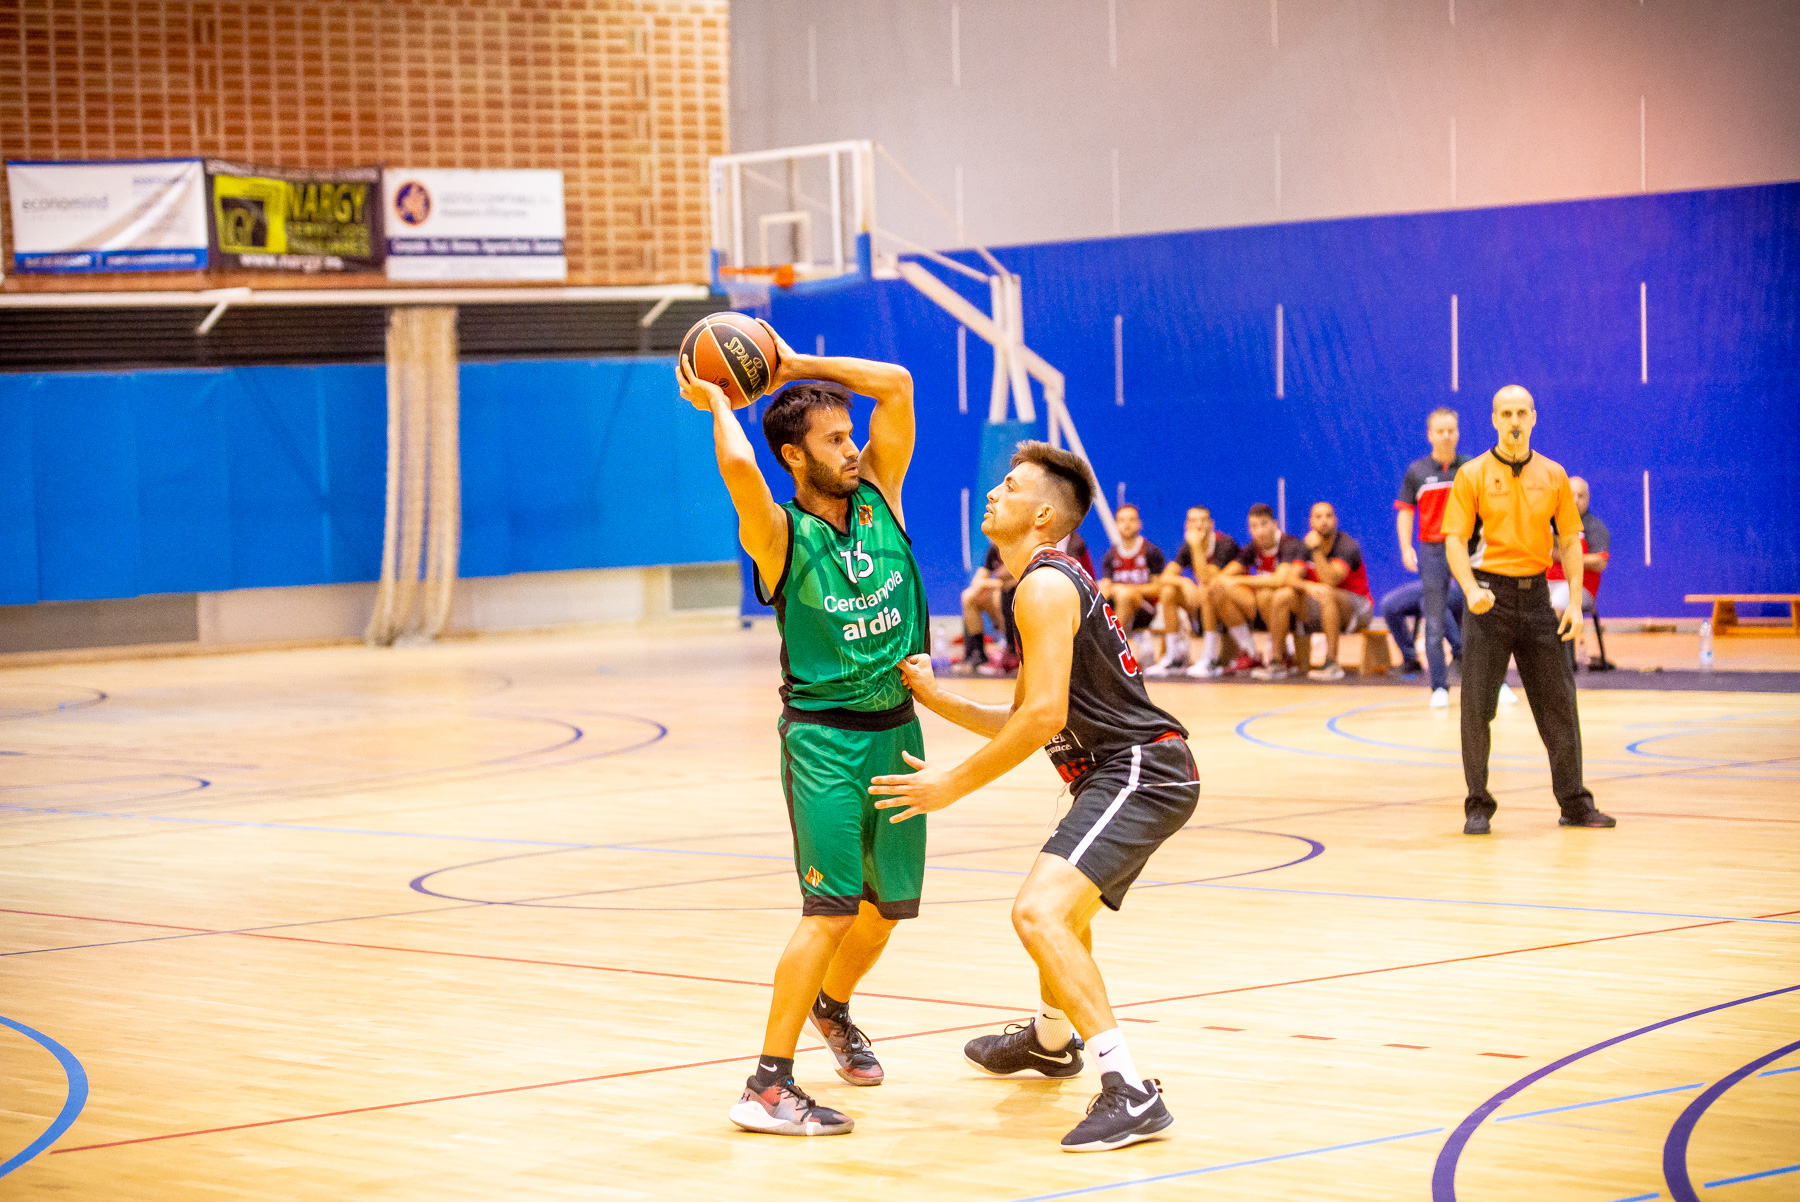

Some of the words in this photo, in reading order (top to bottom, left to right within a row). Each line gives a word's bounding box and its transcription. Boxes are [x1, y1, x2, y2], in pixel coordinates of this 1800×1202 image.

[823, 570, 903, 613] Cerdanyola
[842, 617, 867, 641] al
[869, 606, 902, 635] dia
